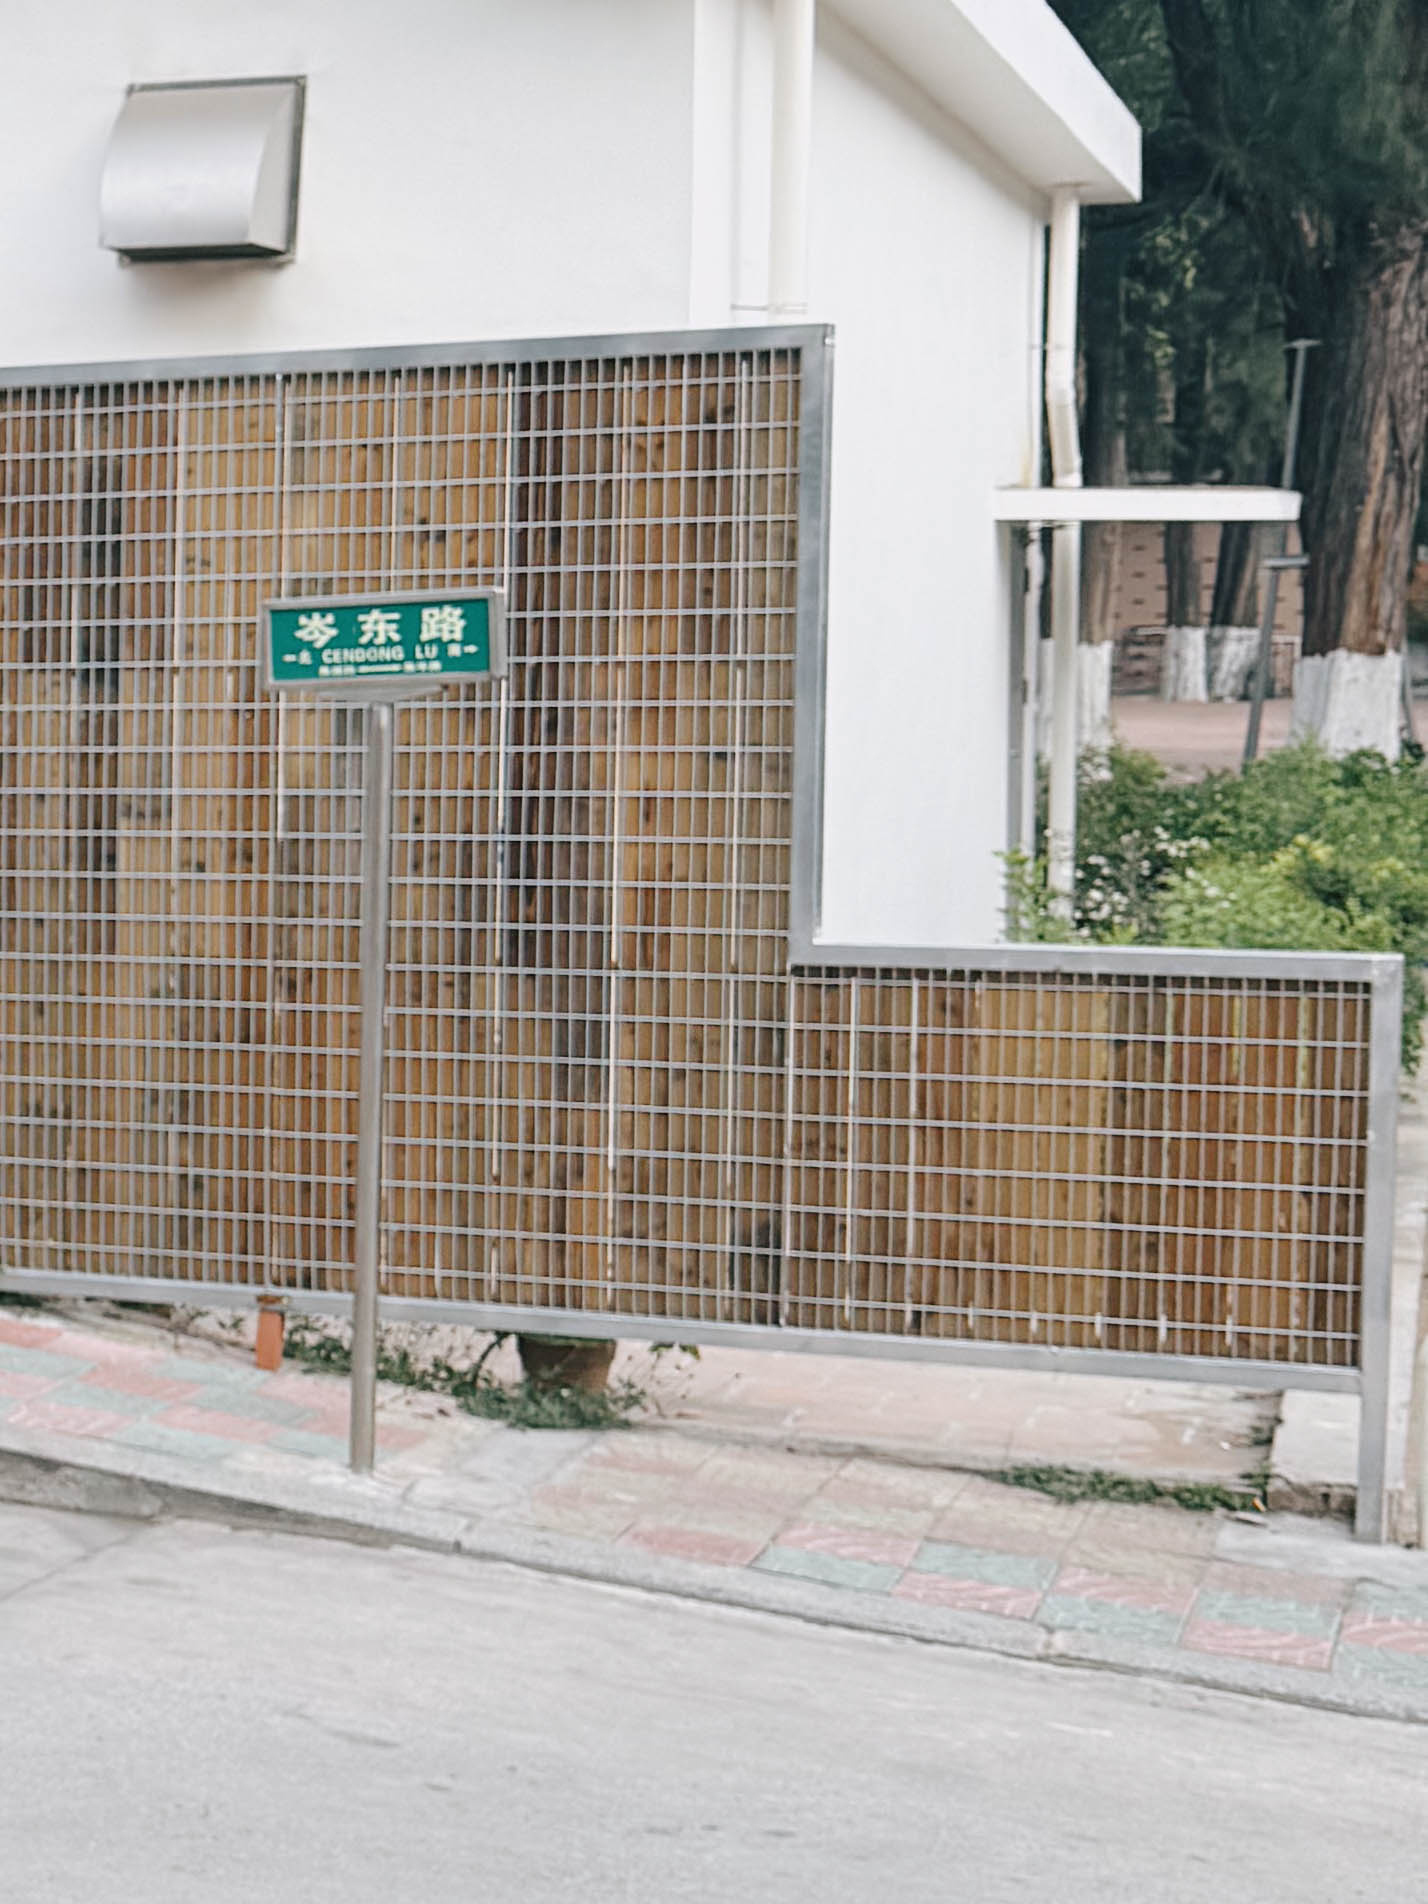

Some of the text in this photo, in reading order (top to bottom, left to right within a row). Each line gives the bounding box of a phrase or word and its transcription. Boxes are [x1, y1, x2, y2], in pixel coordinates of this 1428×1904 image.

[294, 604, 466, 648] 岑东路
[322, 645, 405, 664] CENDONG
[415, 643, 439, 660] LU
